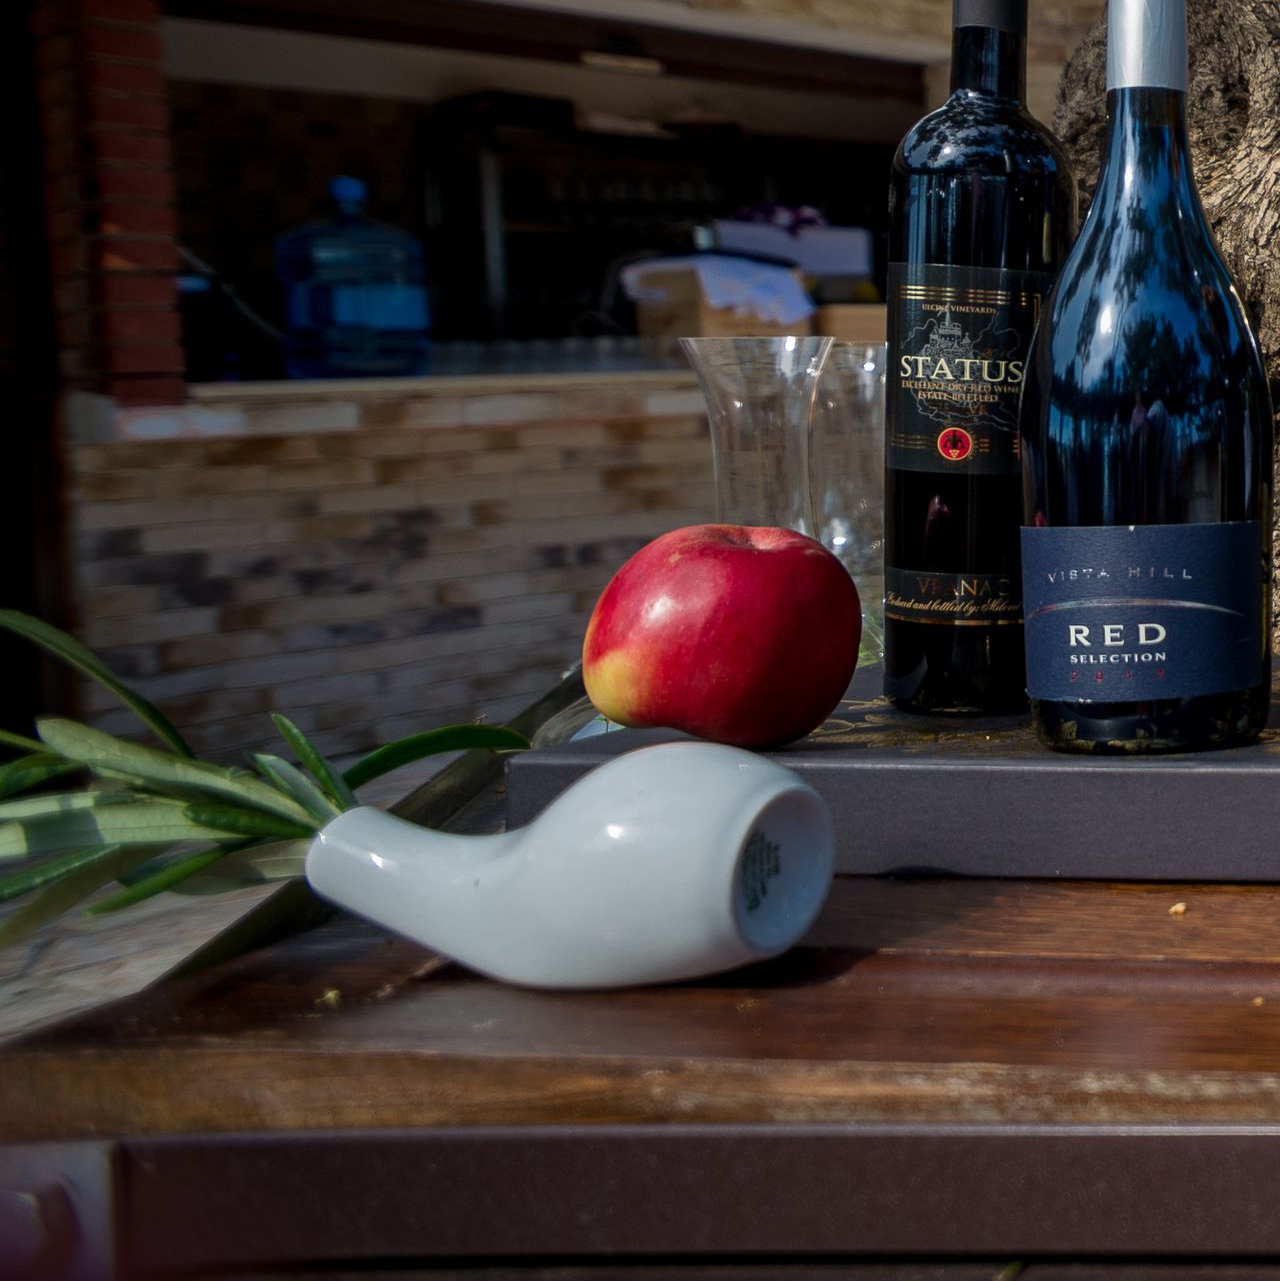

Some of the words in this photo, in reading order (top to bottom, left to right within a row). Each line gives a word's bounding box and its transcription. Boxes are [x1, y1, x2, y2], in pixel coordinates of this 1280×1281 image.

[900, 355, 1024, 383] STATUS
[1048, 567, 1110, 583] VISTA
[1128, 566, 1193, 580] HILL
[1068, 622, 1167, 647] RED
[1070, 651, 1166, 664] SELECTION
[1070, 669, 1166, 683] 2017
